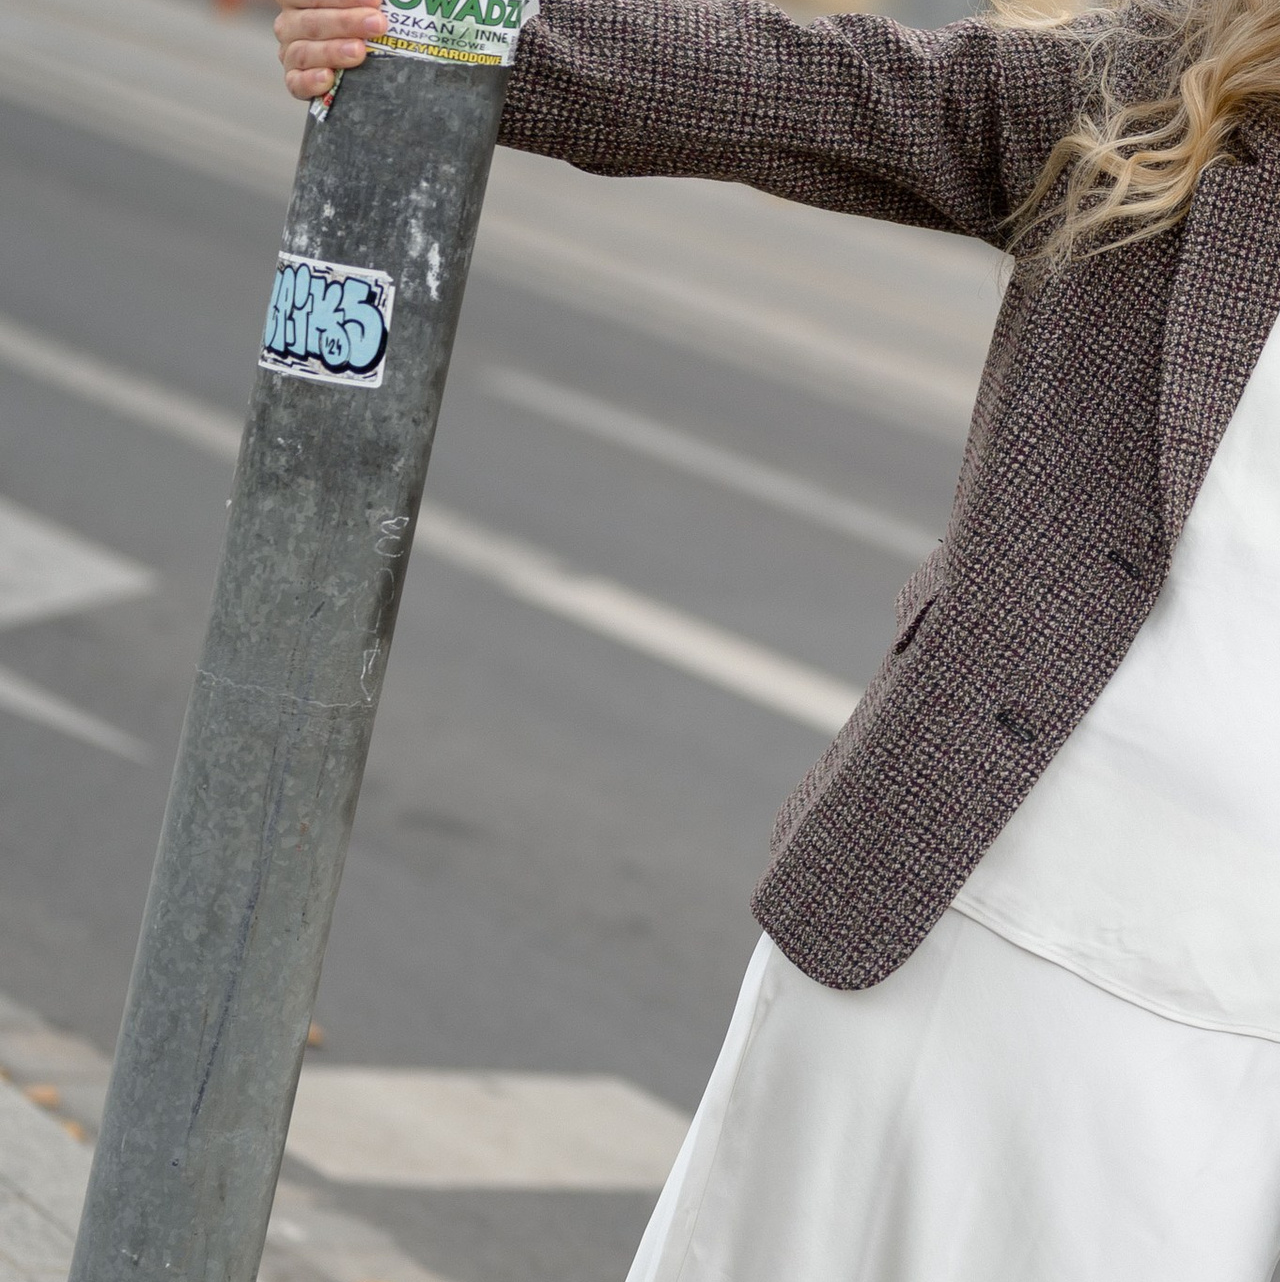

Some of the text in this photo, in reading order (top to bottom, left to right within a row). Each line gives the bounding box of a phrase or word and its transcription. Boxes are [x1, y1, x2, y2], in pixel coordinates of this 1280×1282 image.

[381, 9, 455, 35] SZKAŃ
[475, 29, 509, 44] INNE
[387, 26, 486, 51] ANSPORTOWE
